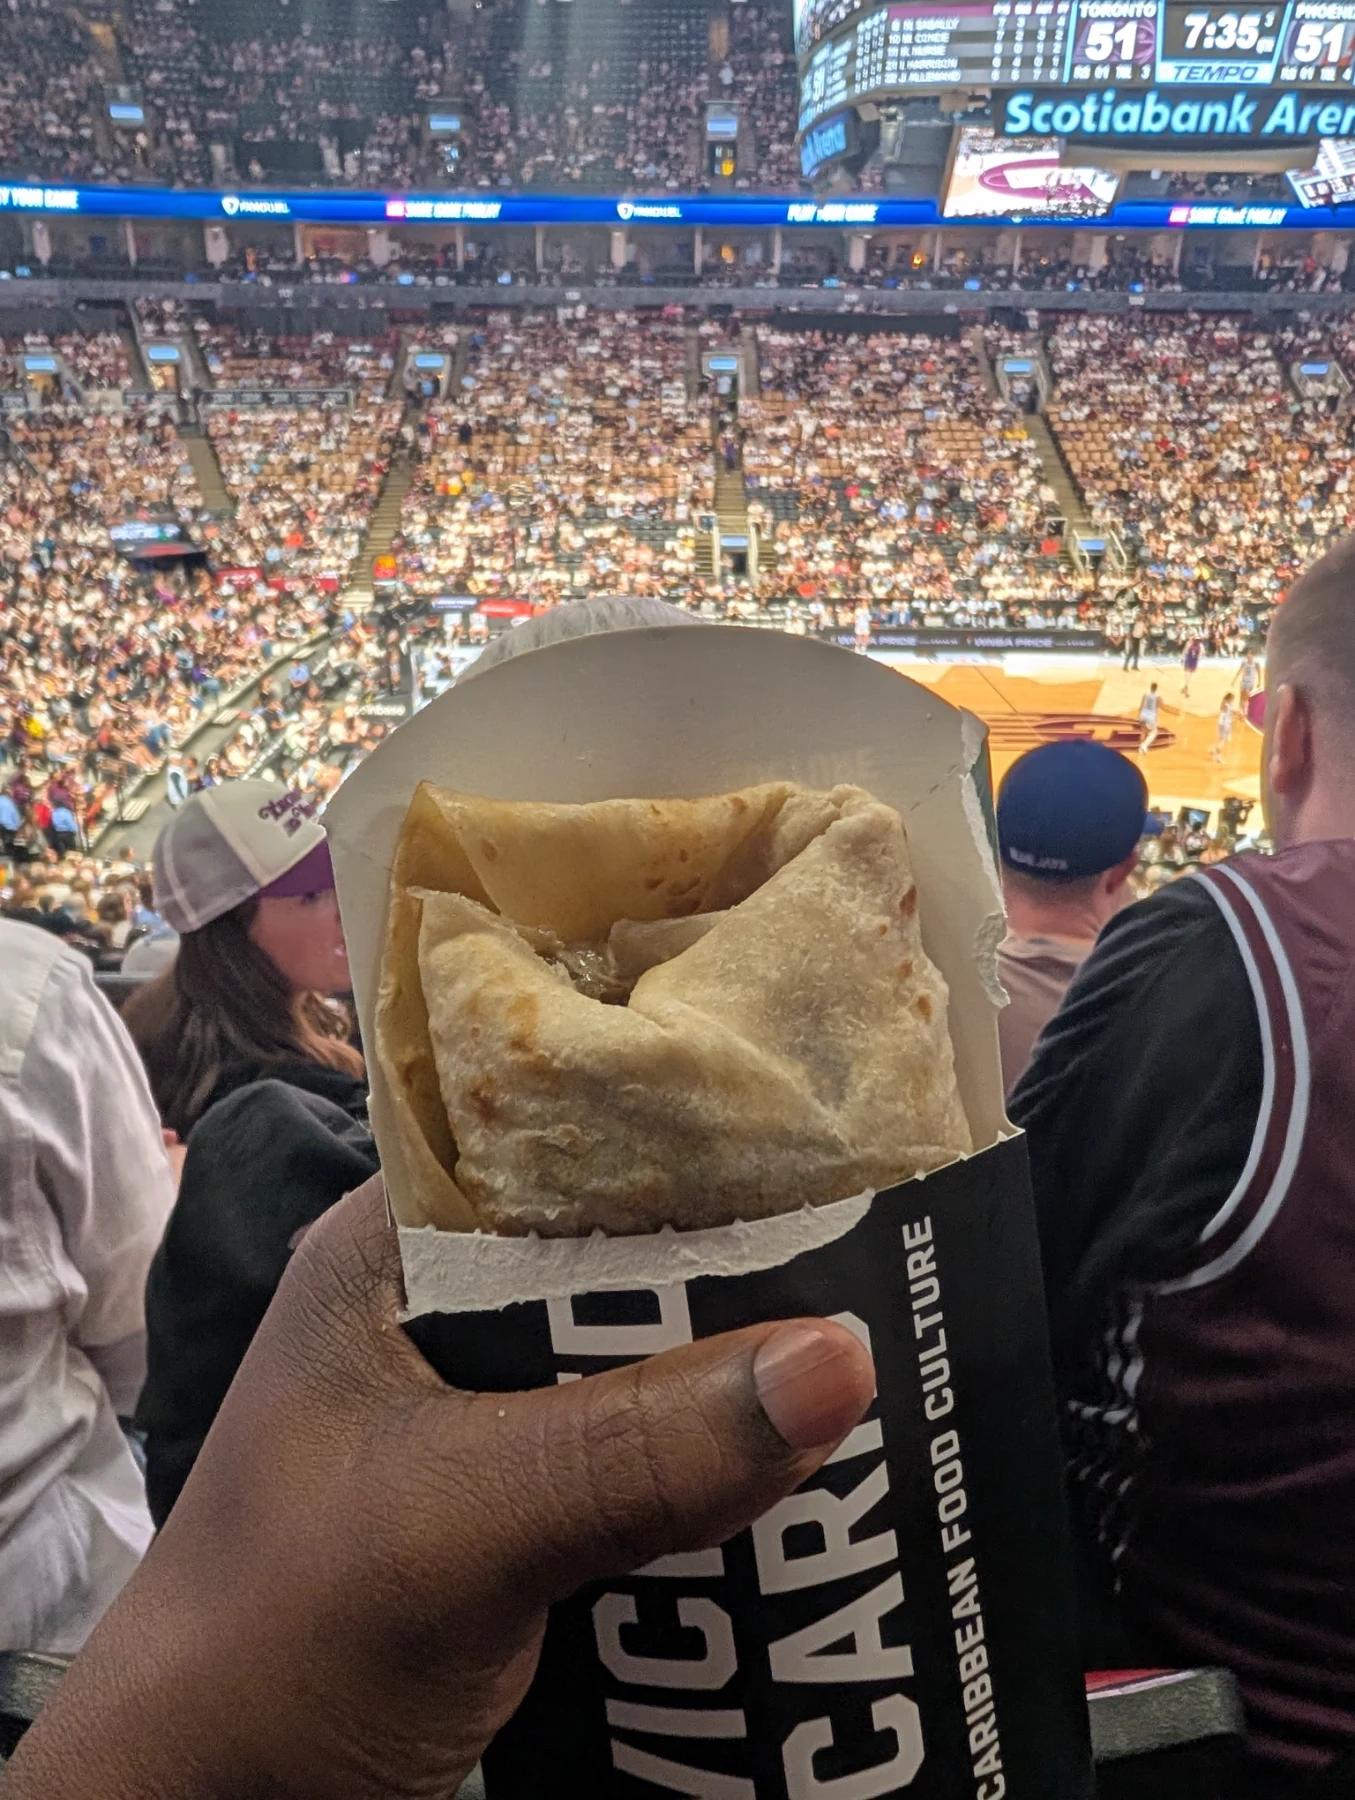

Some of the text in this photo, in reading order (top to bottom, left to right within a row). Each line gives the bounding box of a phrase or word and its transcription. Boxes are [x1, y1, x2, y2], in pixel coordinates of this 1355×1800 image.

[1079, 2, 1157, 18] TORONTO
[1295, 3, 1355, 19] PHOENI
[1084, 20, 1137, 61] 51
[1184, 12, 1261, 49] 7:35
[1294, 22, 1346, 63] 51
[1174, 65, 1259, 81] TEMPO
[1004, 89, 1256, 134] Scotiabank
[902, 1216, 1007, 1800] CARIBBEAN FOOD CULTURE
